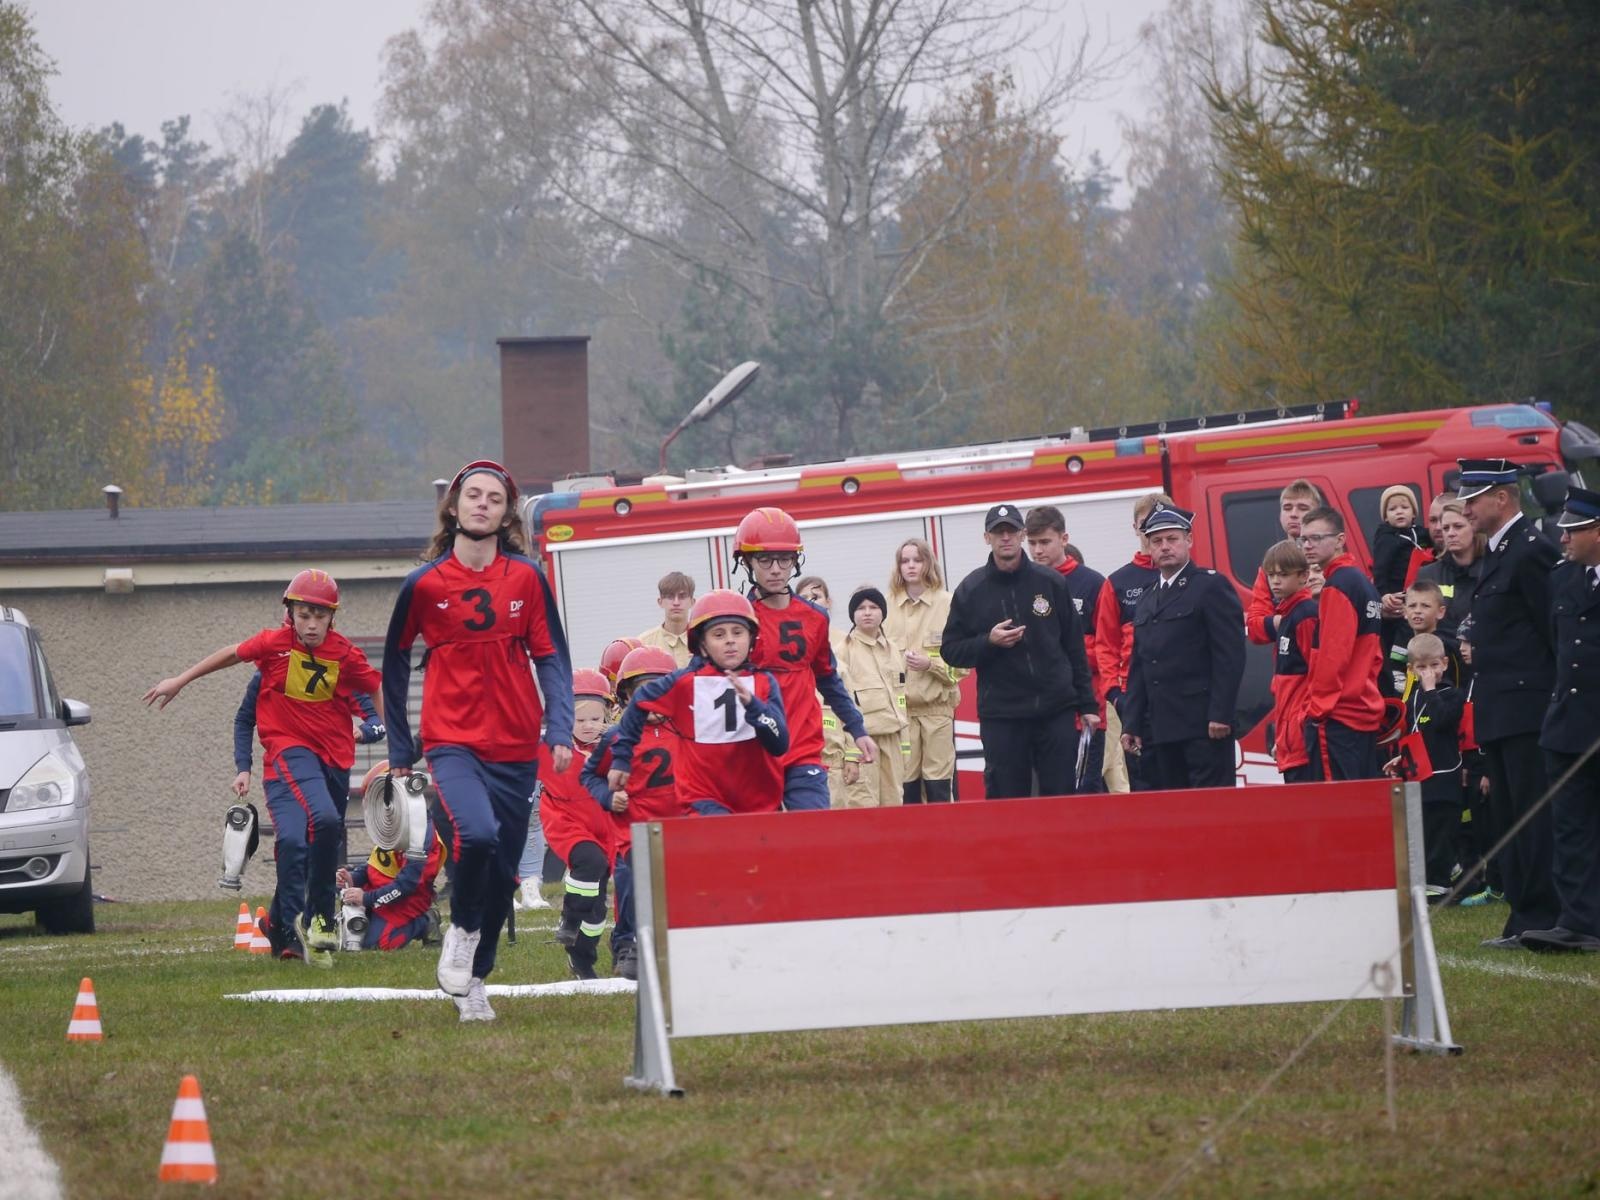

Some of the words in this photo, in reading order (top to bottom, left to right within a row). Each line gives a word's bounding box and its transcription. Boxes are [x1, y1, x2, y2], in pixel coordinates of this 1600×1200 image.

[462, 587, 496, 632] 3
[779, 621, 806, 662] 5
[301, 660, 328, 694] 7
[714, 688, 737, 732] 1
[641, 747, 674, 788] 2
